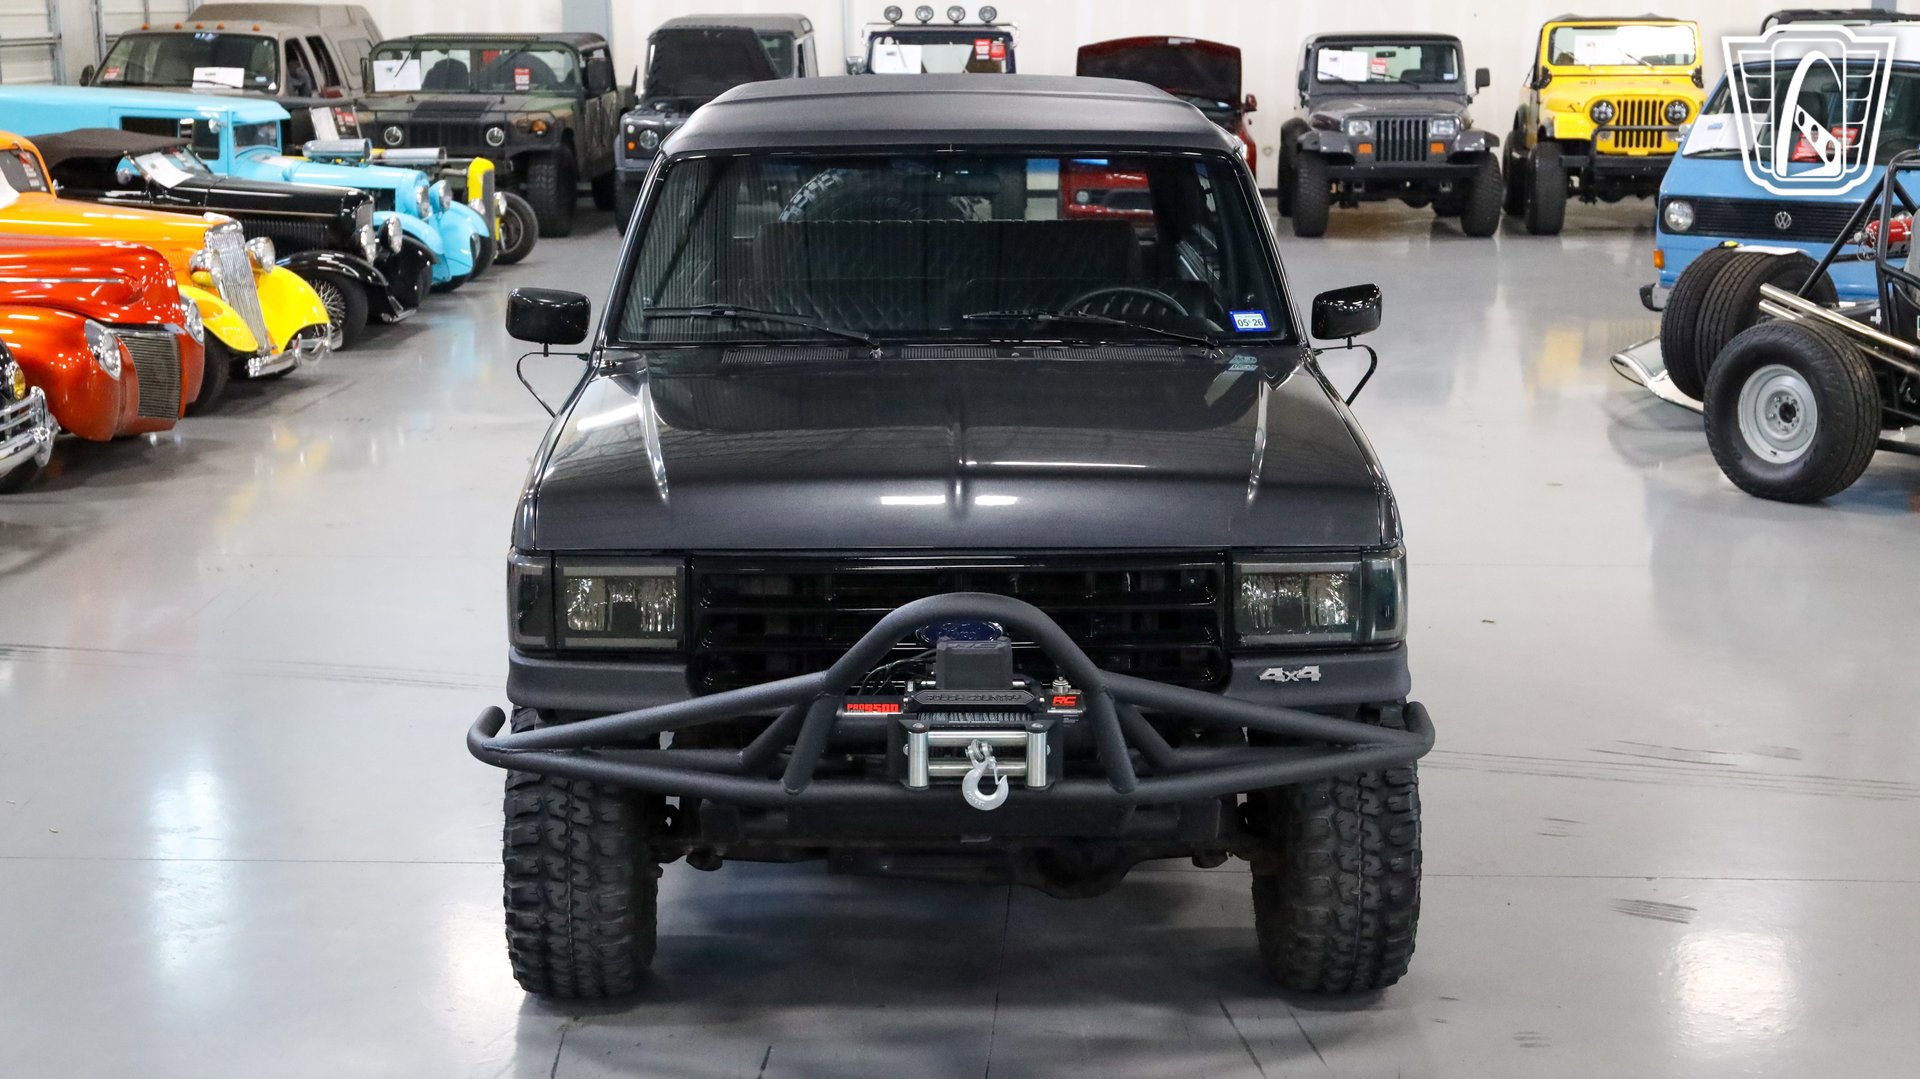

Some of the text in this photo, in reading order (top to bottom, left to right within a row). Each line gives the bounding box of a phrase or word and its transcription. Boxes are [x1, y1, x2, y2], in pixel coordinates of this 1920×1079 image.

[1259, 665, 1321, 682] 4x4
[1053, 696, 1077, 705] RC
[865, 703, 899, 713] 9500
